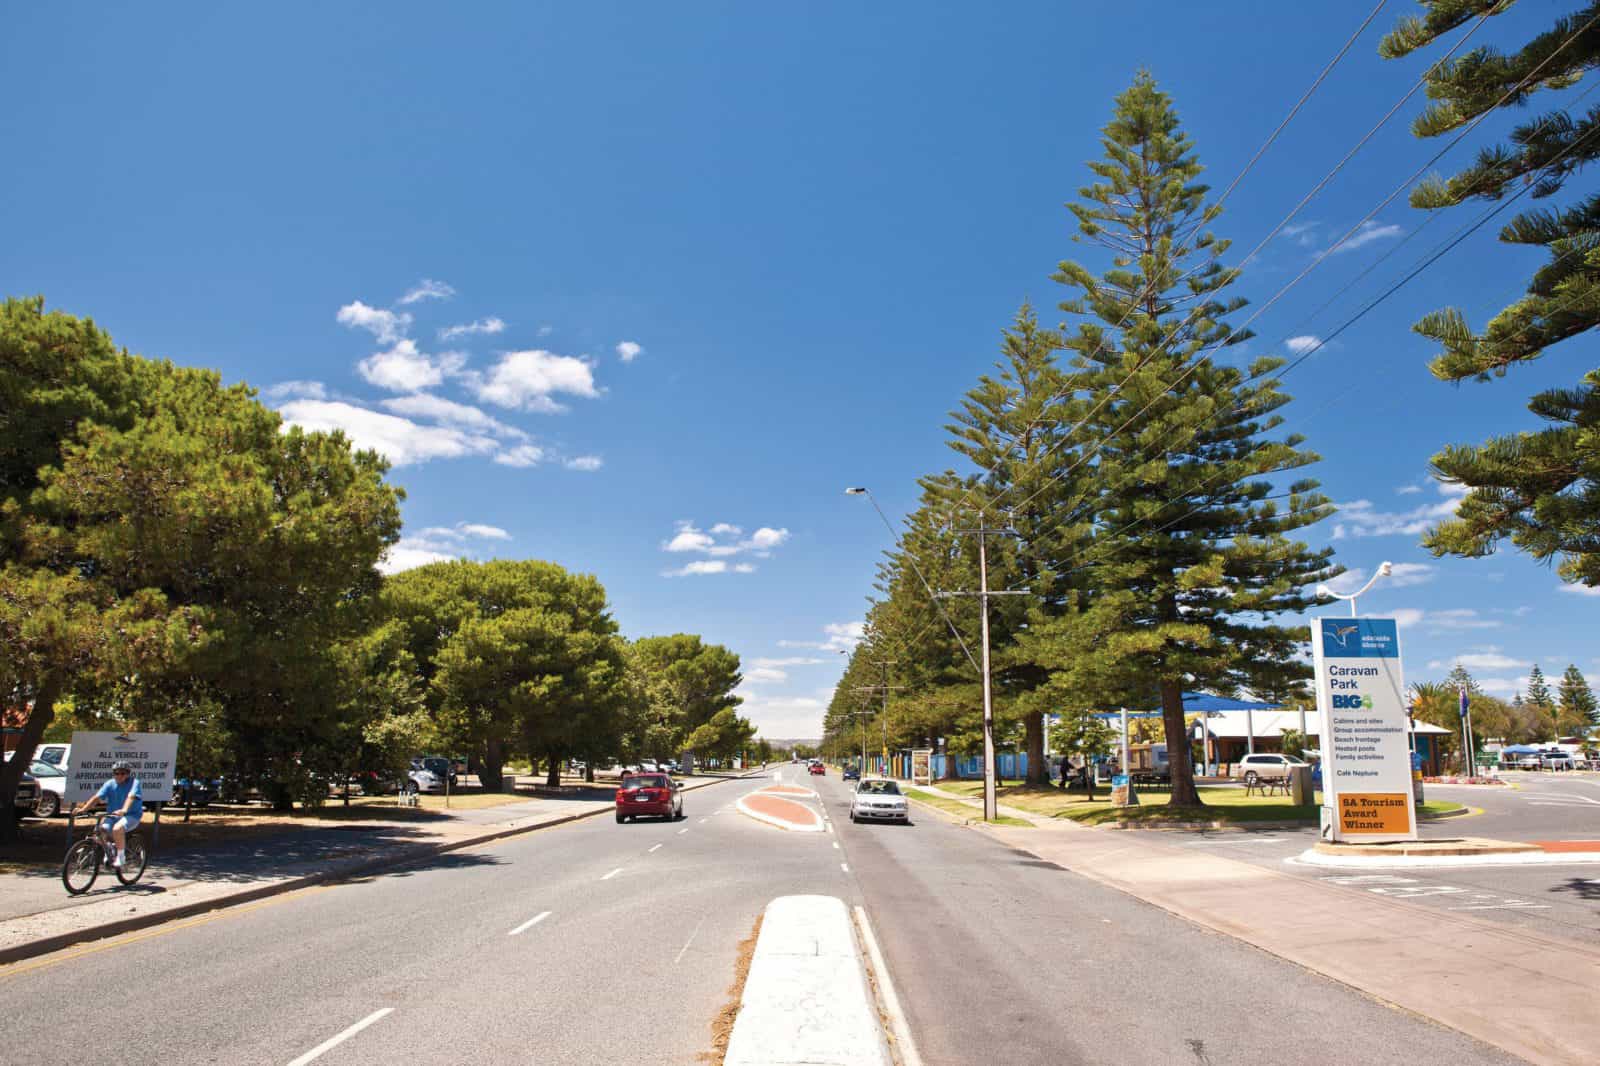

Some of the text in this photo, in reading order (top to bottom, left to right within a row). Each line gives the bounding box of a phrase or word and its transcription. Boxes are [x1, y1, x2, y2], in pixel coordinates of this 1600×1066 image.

[1329, 665, 1378, 676] Caravan
[1330, 678, 1358, 689] Park
[1334, 726, 1353, 734] Group
[1355, 736, 1381, 744] frontage
[99, 751, 149, 759] ALL VEHICLES
[1336, 753, 1356, 761] Family
[81, 761, 92, 769] NO
[79, 782, 91, 790] VIA
[1343, 797, 1404, 807] SA Tourism
[1344, 809, 1378, 818] Award
[1344, 821, 1384, 829] Winner
